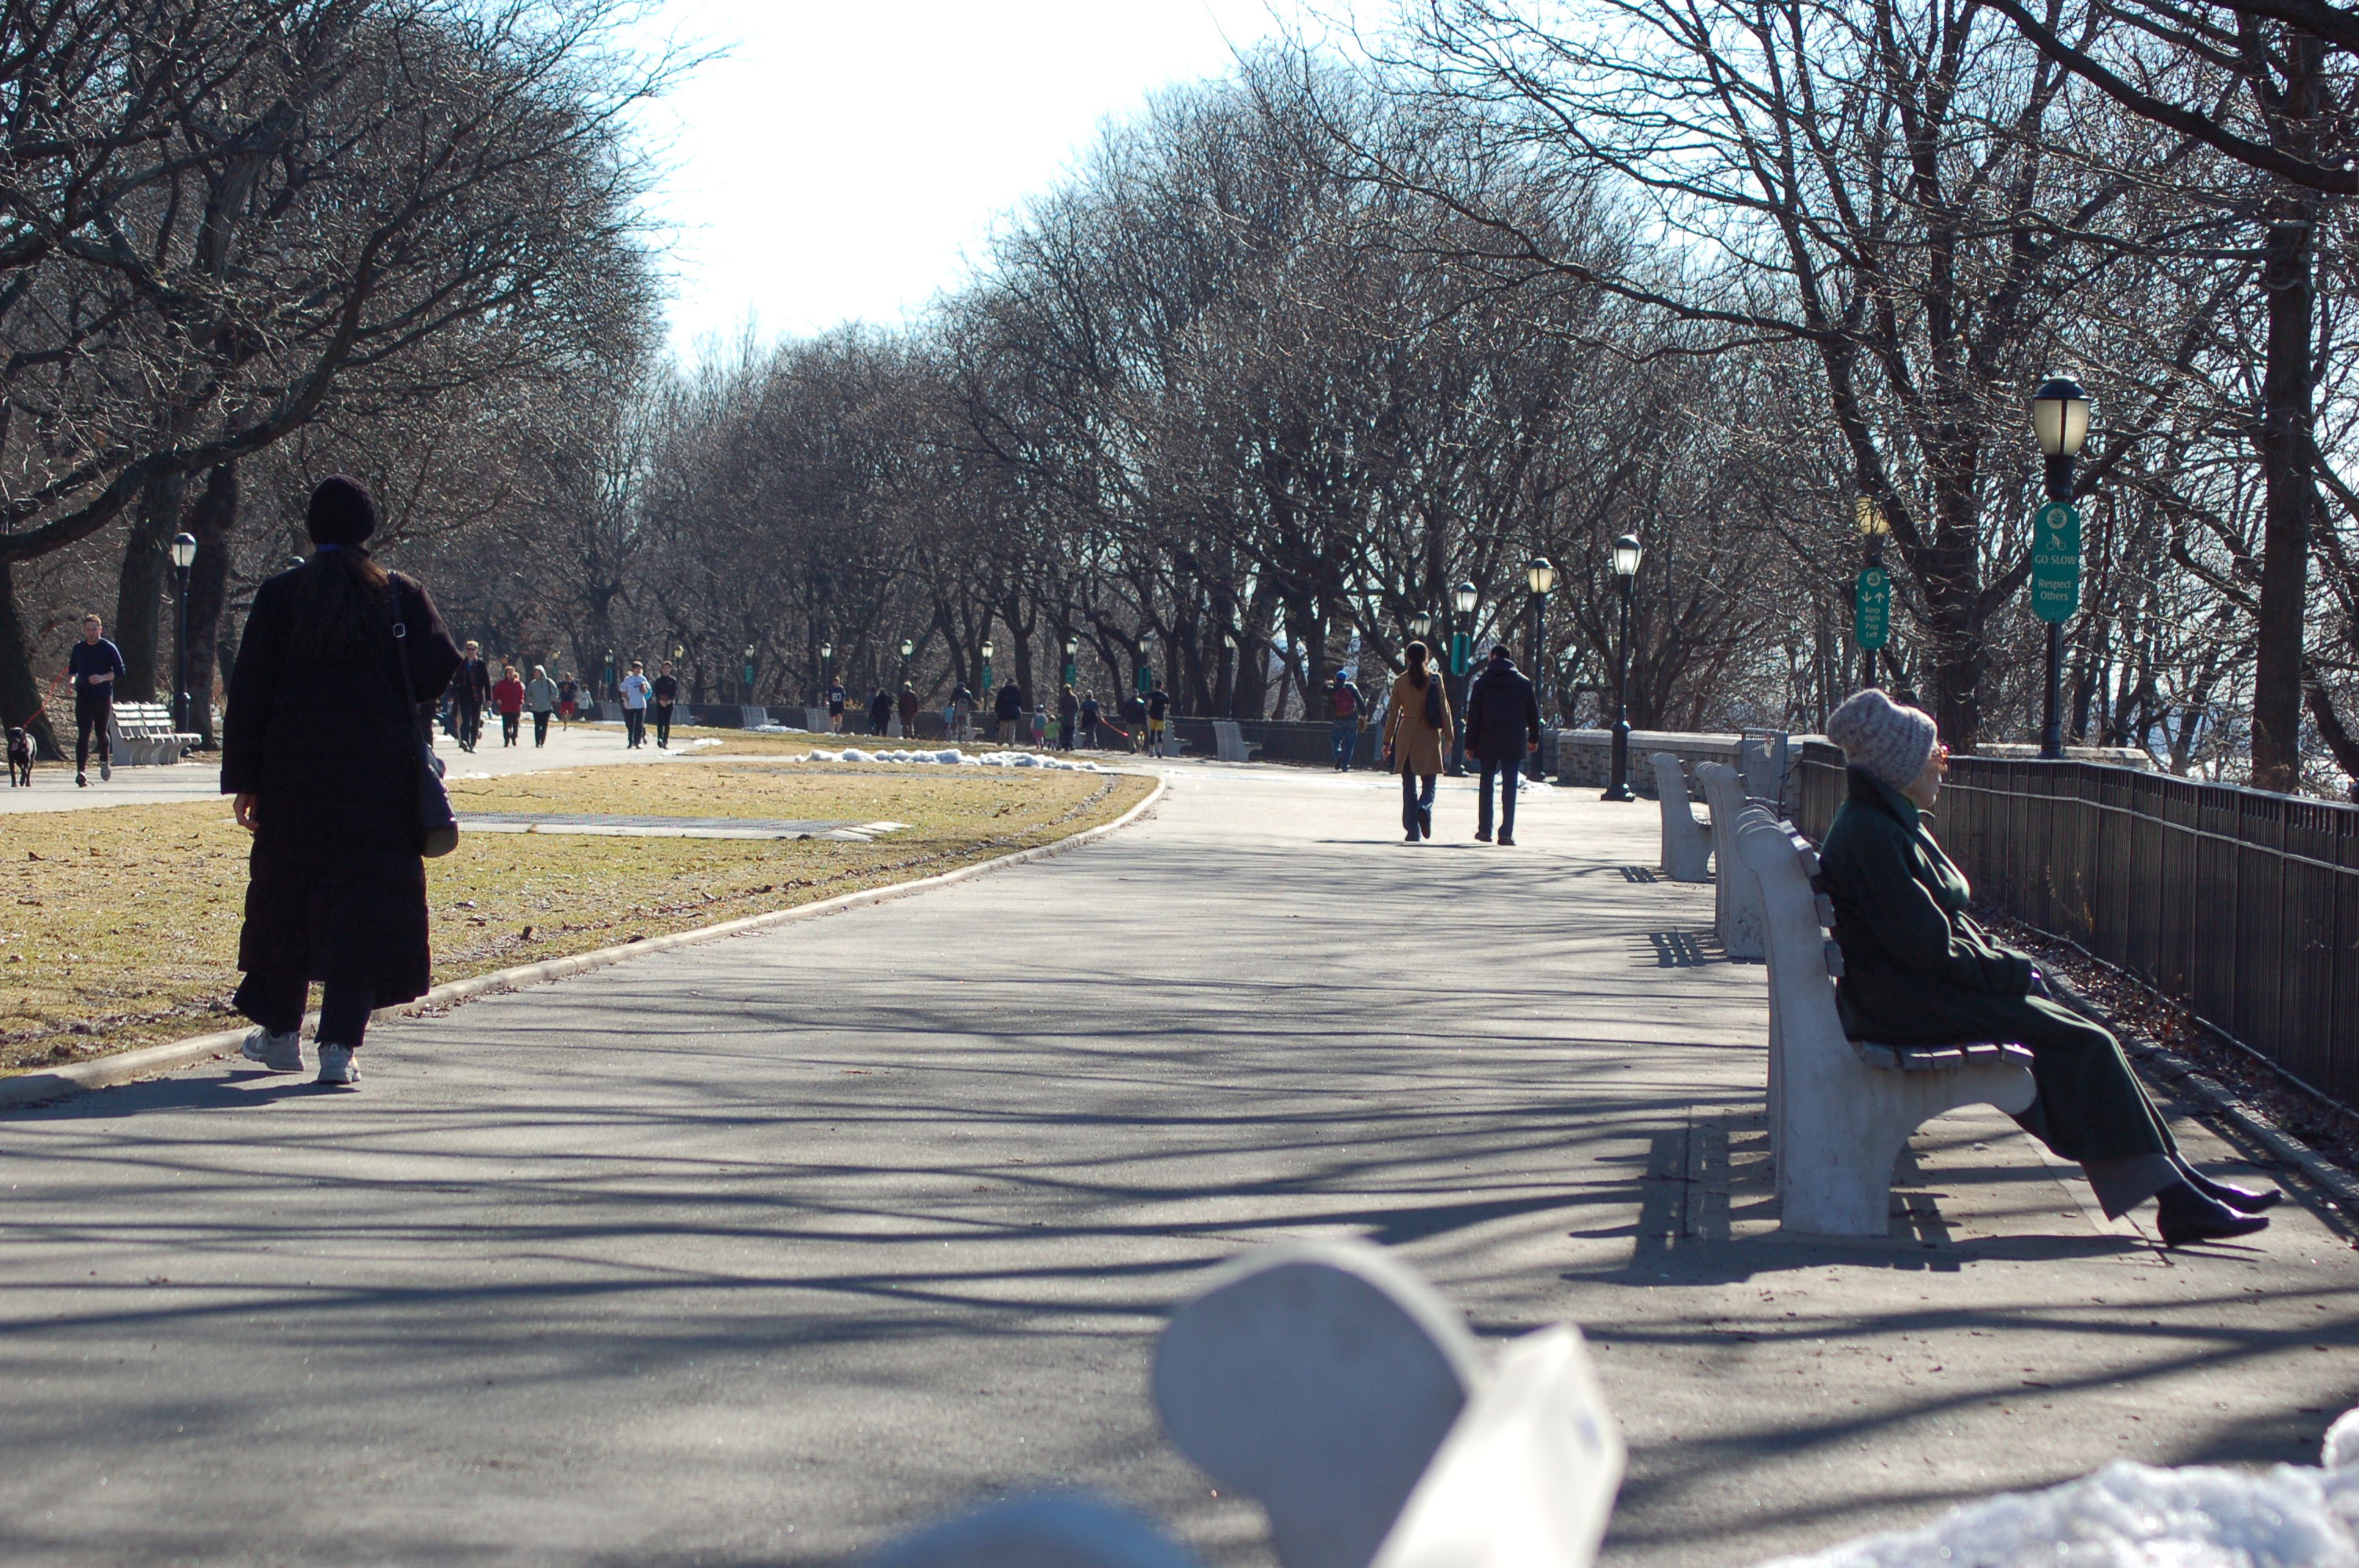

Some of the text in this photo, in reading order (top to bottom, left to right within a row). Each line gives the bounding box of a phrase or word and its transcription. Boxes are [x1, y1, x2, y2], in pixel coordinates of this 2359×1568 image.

[2034, 554, 2077, 565] GO SLOW
[2038, 579, 2071, 590] Respect
[2040, 590, 2069, 601] Others
